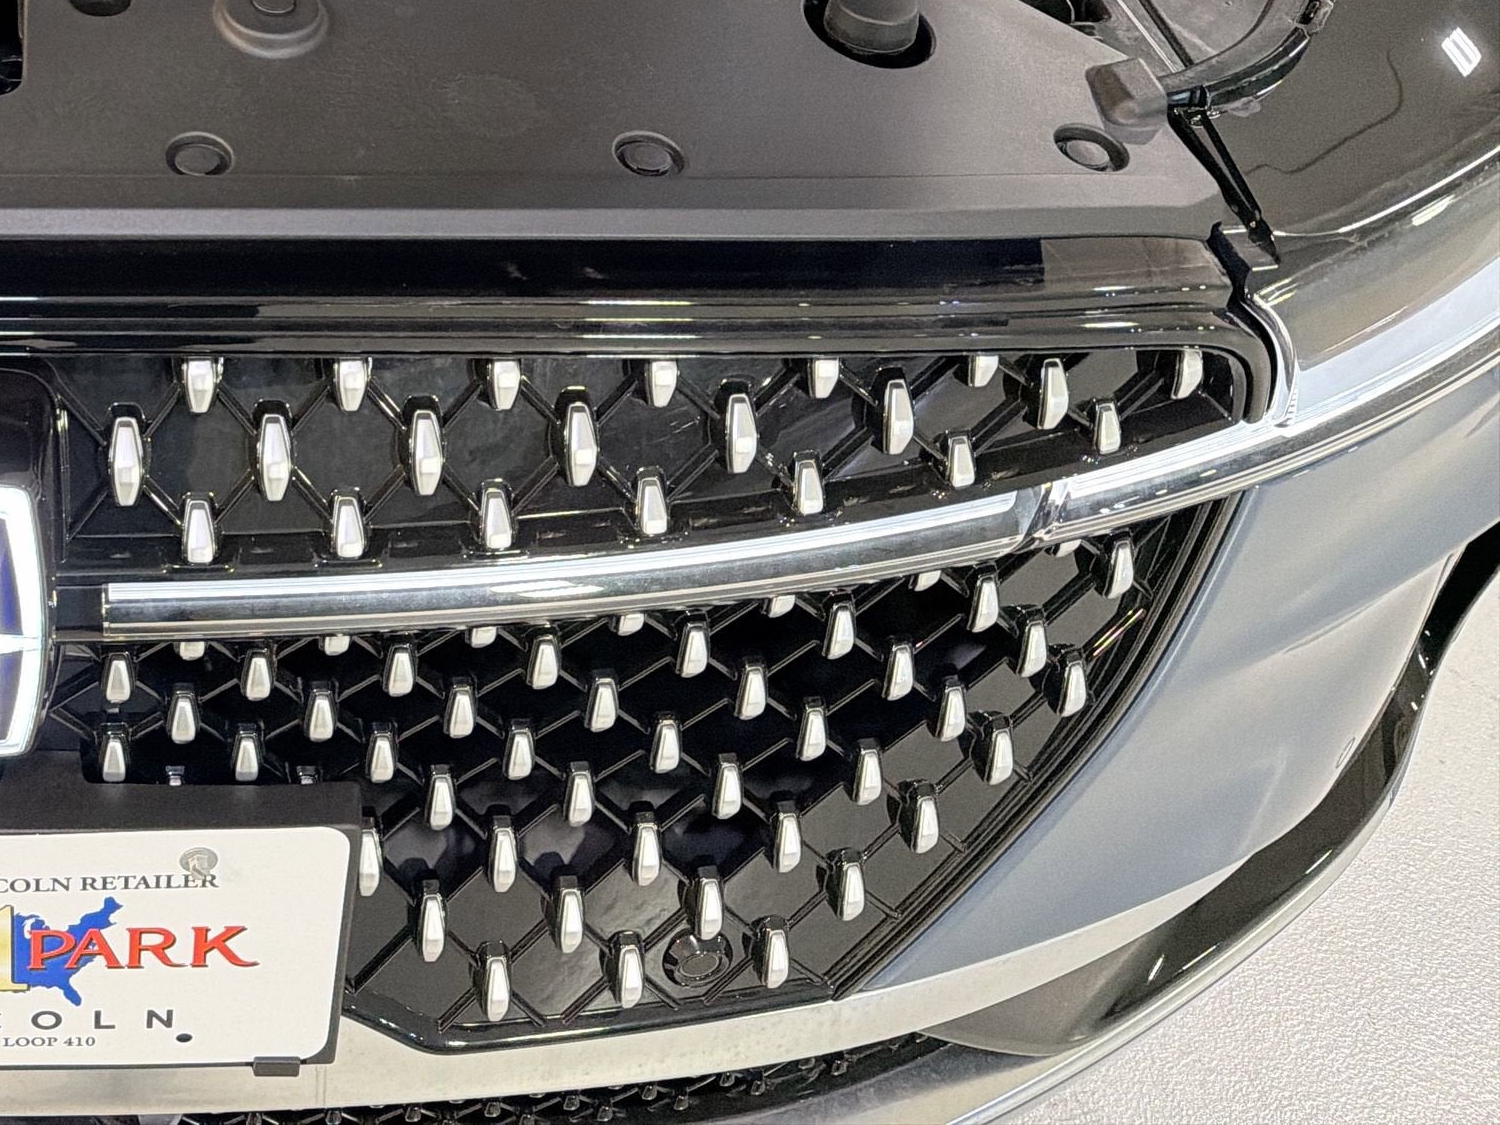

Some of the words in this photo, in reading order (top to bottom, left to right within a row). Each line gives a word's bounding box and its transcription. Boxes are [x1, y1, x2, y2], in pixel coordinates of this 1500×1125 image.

[79, 873, 220, 891] RETAILER
[28, 925, 260, 971] PARK
[2, 1036, 58, 1047] LOOP
[63, 1036, 96, 1047] 410
